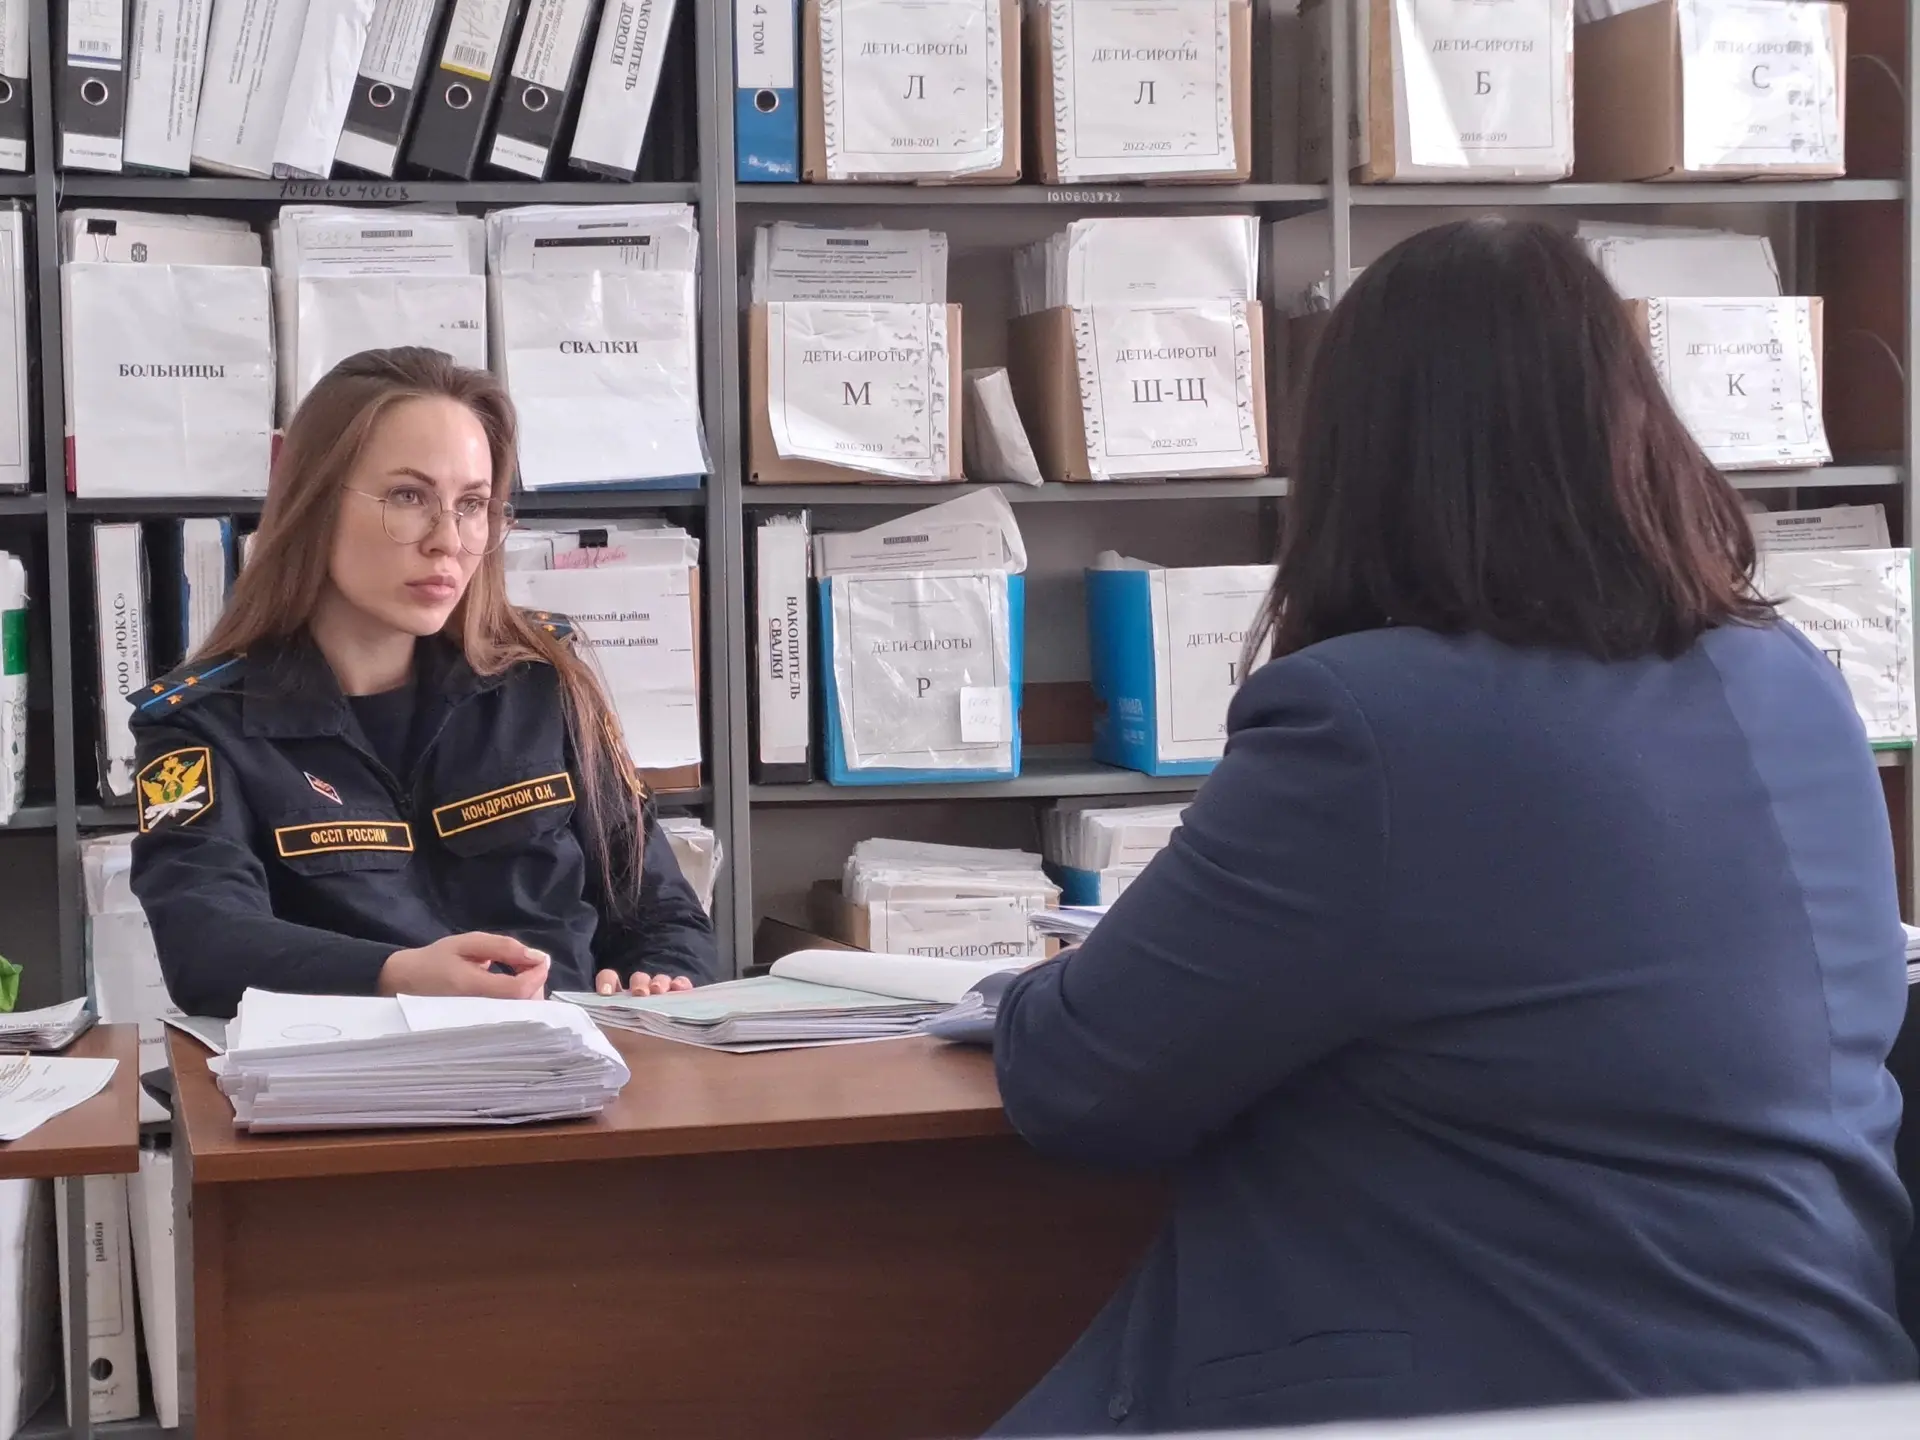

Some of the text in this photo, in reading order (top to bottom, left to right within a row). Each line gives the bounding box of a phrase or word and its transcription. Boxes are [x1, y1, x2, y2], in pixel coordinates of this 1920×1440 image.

[612, 3, 634, 66] ДОРОГИ
[751, 3, 768, 56] 4 ТОМ
[624, 0, 653, 91] АКОПИТЕЛЬ
[860, 41, 969, 56] ДЕТИ-СИРОТЫ
[1092, 47, 1198, 62] ДЕТИ-СИРОТЫ
[1432, 38, 1534, 53] ДЕТИ-СИРОТЫ
[1714, 40, 1814, 55] ДЕТИ-СИРО
[903, 74, 926, 100] Л
[1474, 70, 1492, 96] Б
[1752, 64, 1771, 89] С
[1133, 80, 1157, 105] Л
[559, 339, 639, 356] СВАЛКИ
[802, 350, 912, 365] ДЕТИ-СИРОТЫ
[1115, 345, 1218, 363] ДЕТИ-СИРОТЫ
[1686, 342, 1784, 356] ДЕТИ-СИРОТЫ
[118, 363, 226, 380] БОЛЬНИЦЫ
[841, 380, 872, 407] М
[1132, 376, 1209, 408] Ш-Щ
[1726, 372, 1748, 397] К
[833, 441, 884, 454] 20162019
[571, 610, 650, 622] менский район
[114, 592, 130, 696] ООО «РОКАС»
[628, 635, 659, 647] район
[770, 617, 784, 681] СВАЛКИ
[785, 595, 801, 700] НАКОПИТЕЛЬ
[871, 637, 973, 656] ДЕТИ-СИРОТЫ
[916, 676, 931, 699] Р
[460, 784, 557, 822] КОНДРАТЮК О.Н.
[310, 827, 389, 845] ФССП РОССИИ
[93, 1221, 107, 1261] район
